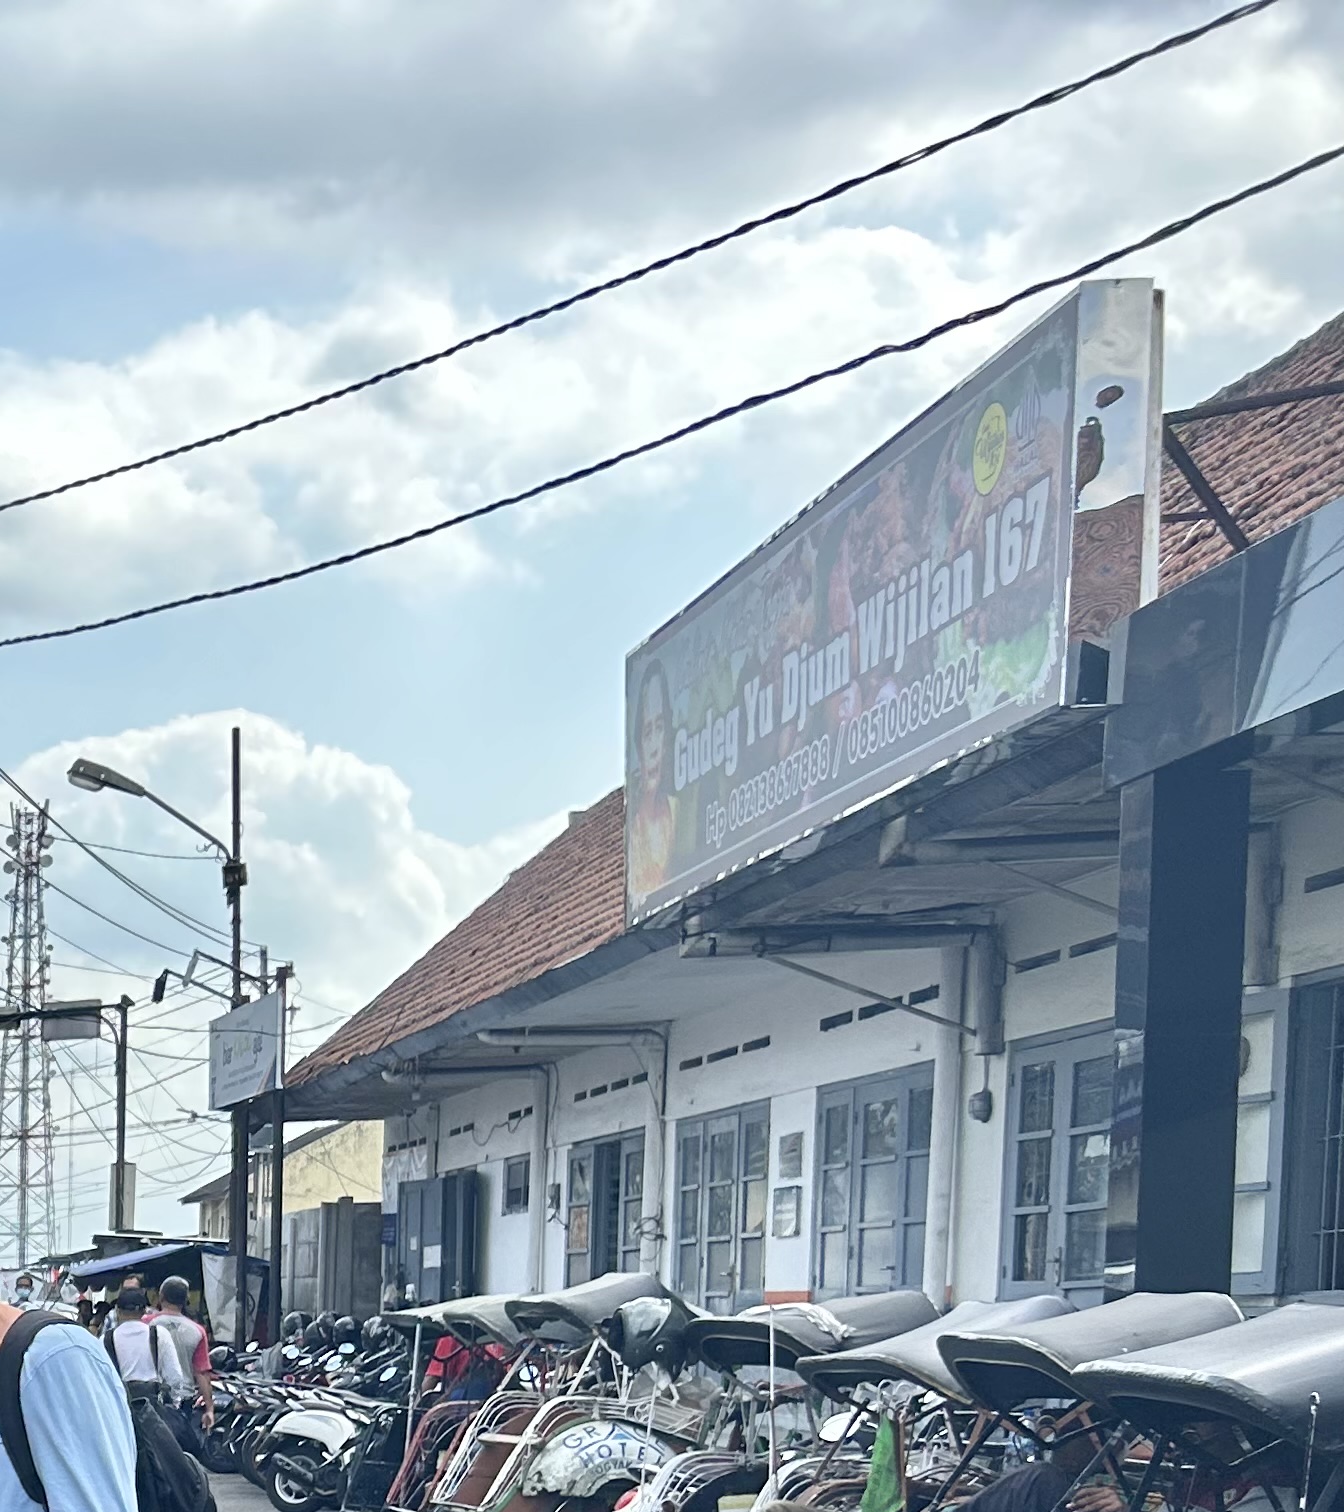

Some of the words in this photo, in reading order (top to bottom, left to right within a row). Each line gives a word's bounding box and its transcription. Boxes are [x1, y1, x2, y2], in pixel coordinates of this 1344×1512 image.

[674, 705, 739, 791] Gudeg
[744, 675, 773, 746] Yu
[781, 631, 850, 731] Djum
[856, 548, 973, 673] Wijilan
[982, 476, 1052, 598] 167
[706, 801, 727, 849] Hp
